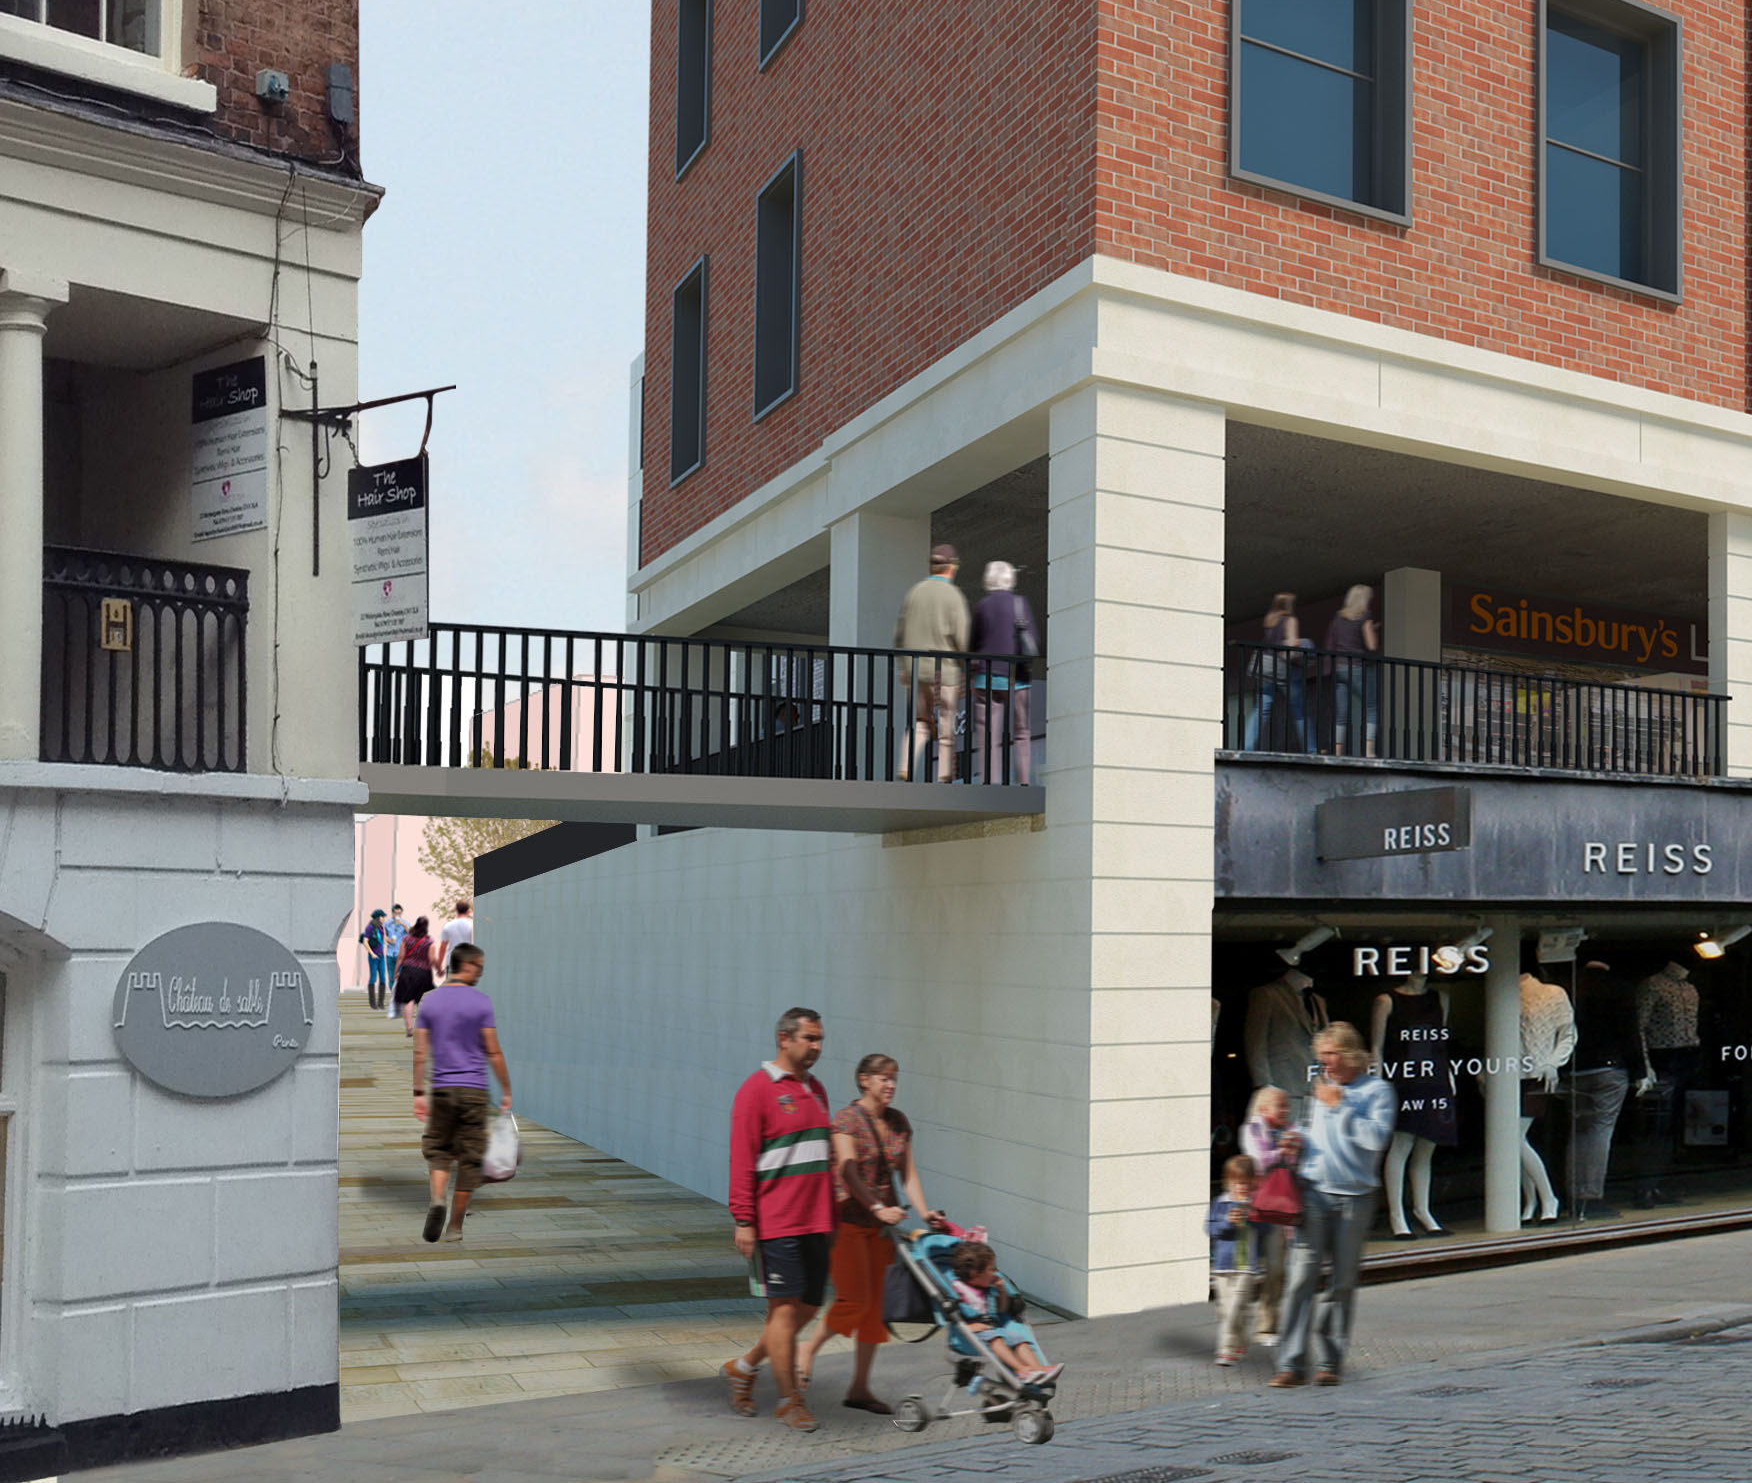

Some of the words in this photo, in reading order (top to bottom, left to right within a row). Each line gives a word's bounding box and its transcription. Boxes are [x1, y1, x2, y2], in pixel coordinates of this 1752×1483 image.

[227, 387, 258, 405] Shop
[373, 469, 396, 487] The
[357, 488, 384, 507] Hair
[385, 485, 416, 506] Shop
[1469, 593, 1679, 663] Sainsbury's
[1384, 822, 1451, 851] REISS
[1584, 842, 1714, 874] REISS
[1353, 945, 1490, 976] REISS
[168, 975, 214, 1014] Château
[219, 977, 231, 1012] de
[237, 978, 263, 1014] sable
[1401, 1028, 1449, 1041] REISS
[1306, 1060, 1434, 1082] FEVER
[1451, 1055, 1534, 1076] YOURS
[1401, 1099, 1424, 1111] AW
[1431, 1098, 1448, 1109] 15
